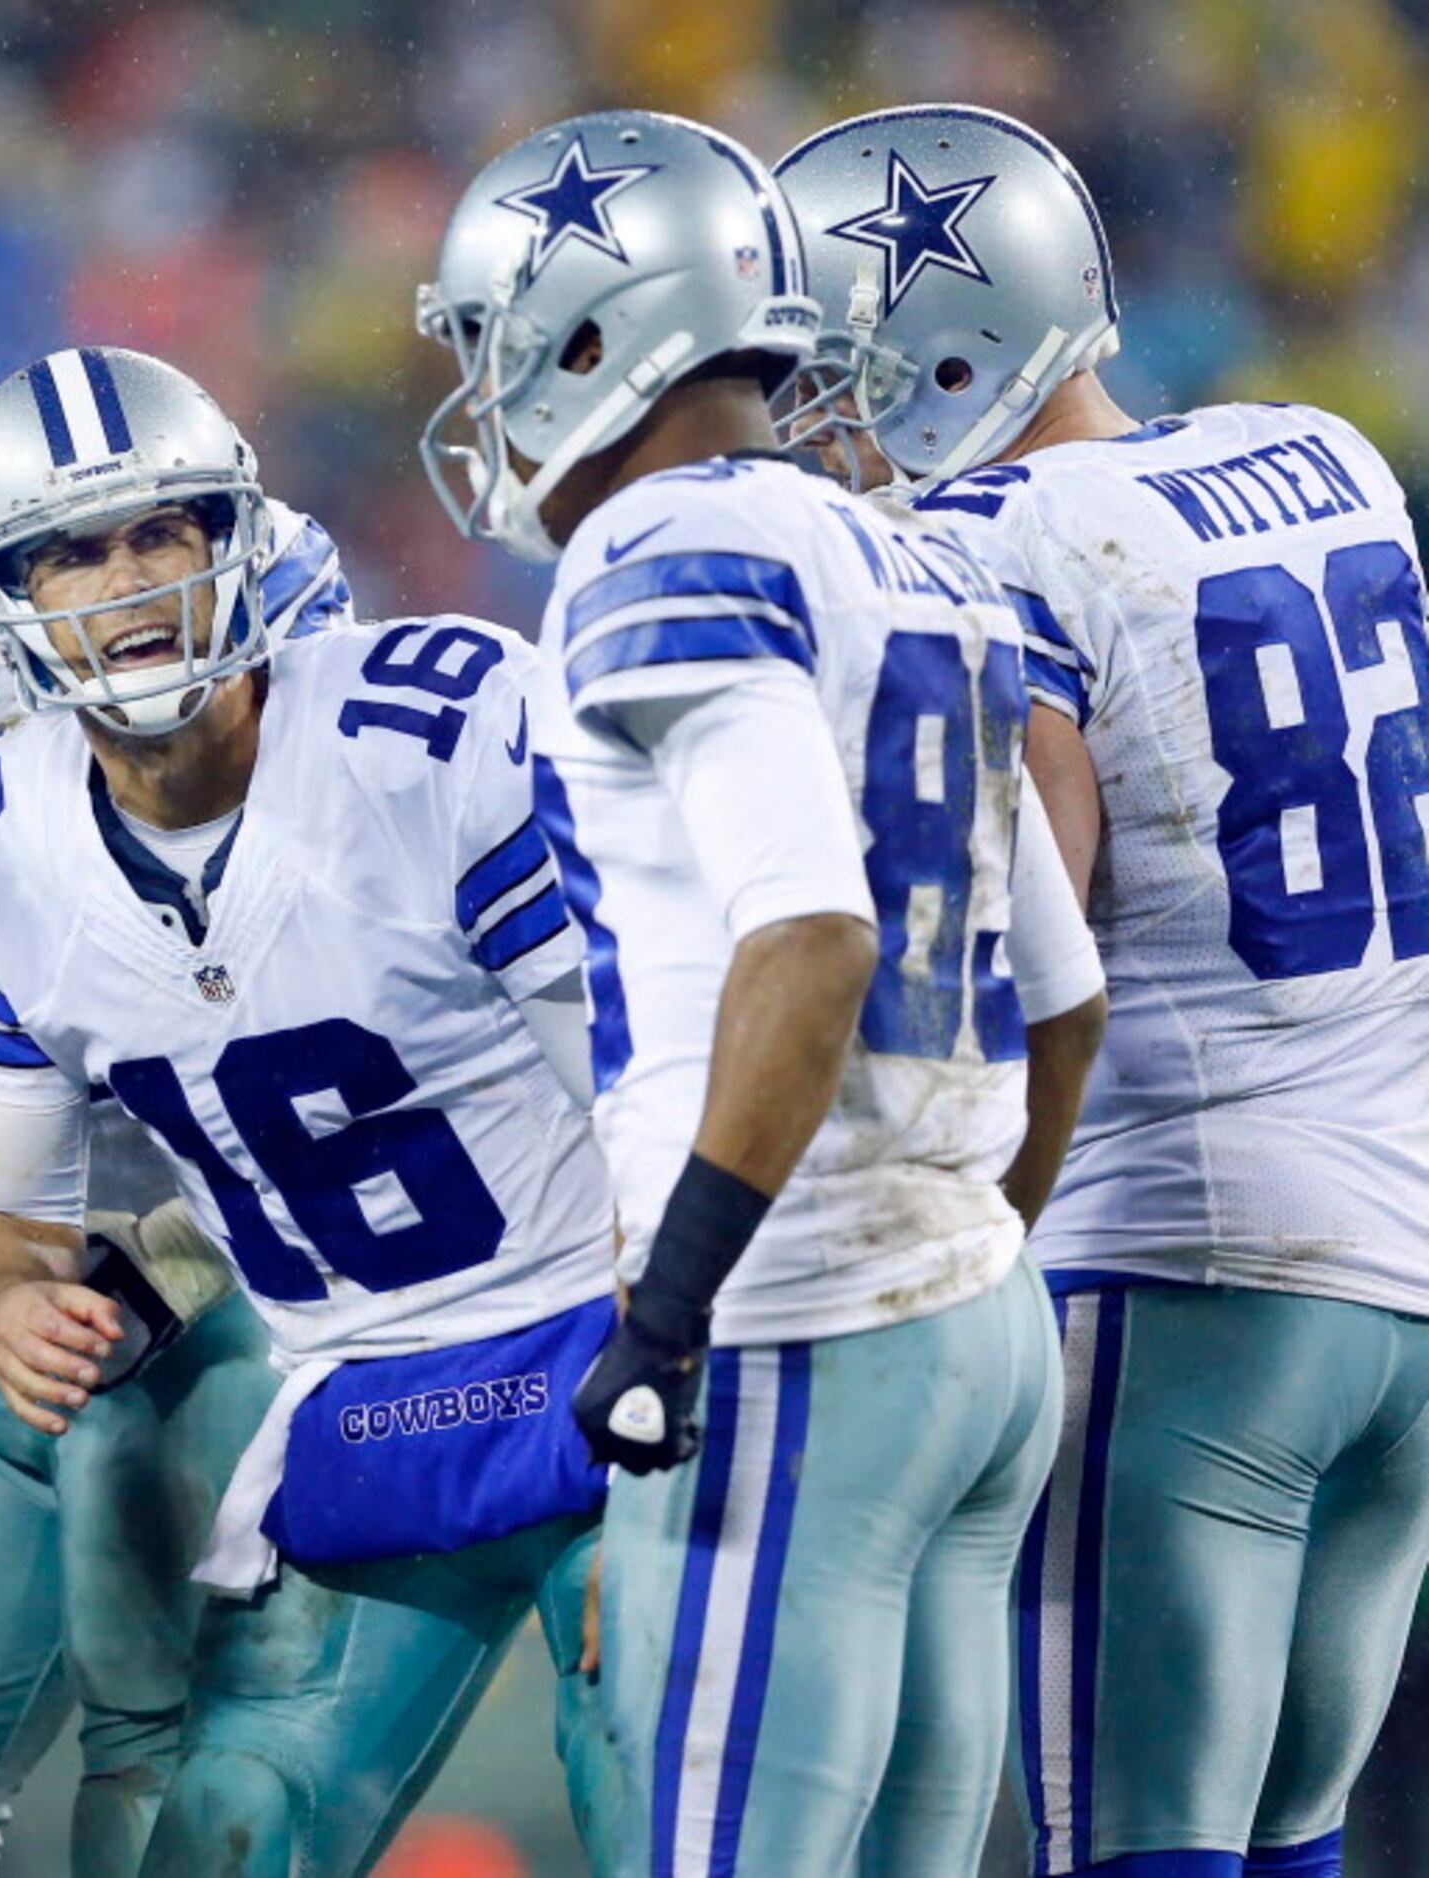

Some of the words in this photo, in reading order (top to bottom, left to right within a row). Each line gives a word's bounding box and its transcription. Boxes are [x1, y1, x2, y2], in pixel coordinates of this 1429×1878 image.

[1134, 434, 1370, 541] WITTEN
[337, 624, 506, 763] 16
[1195, 539, 1429, 980] 82
[108, 1017, 507, 1303] 16
[340, 1371, 549, 1444] COWBOYS
